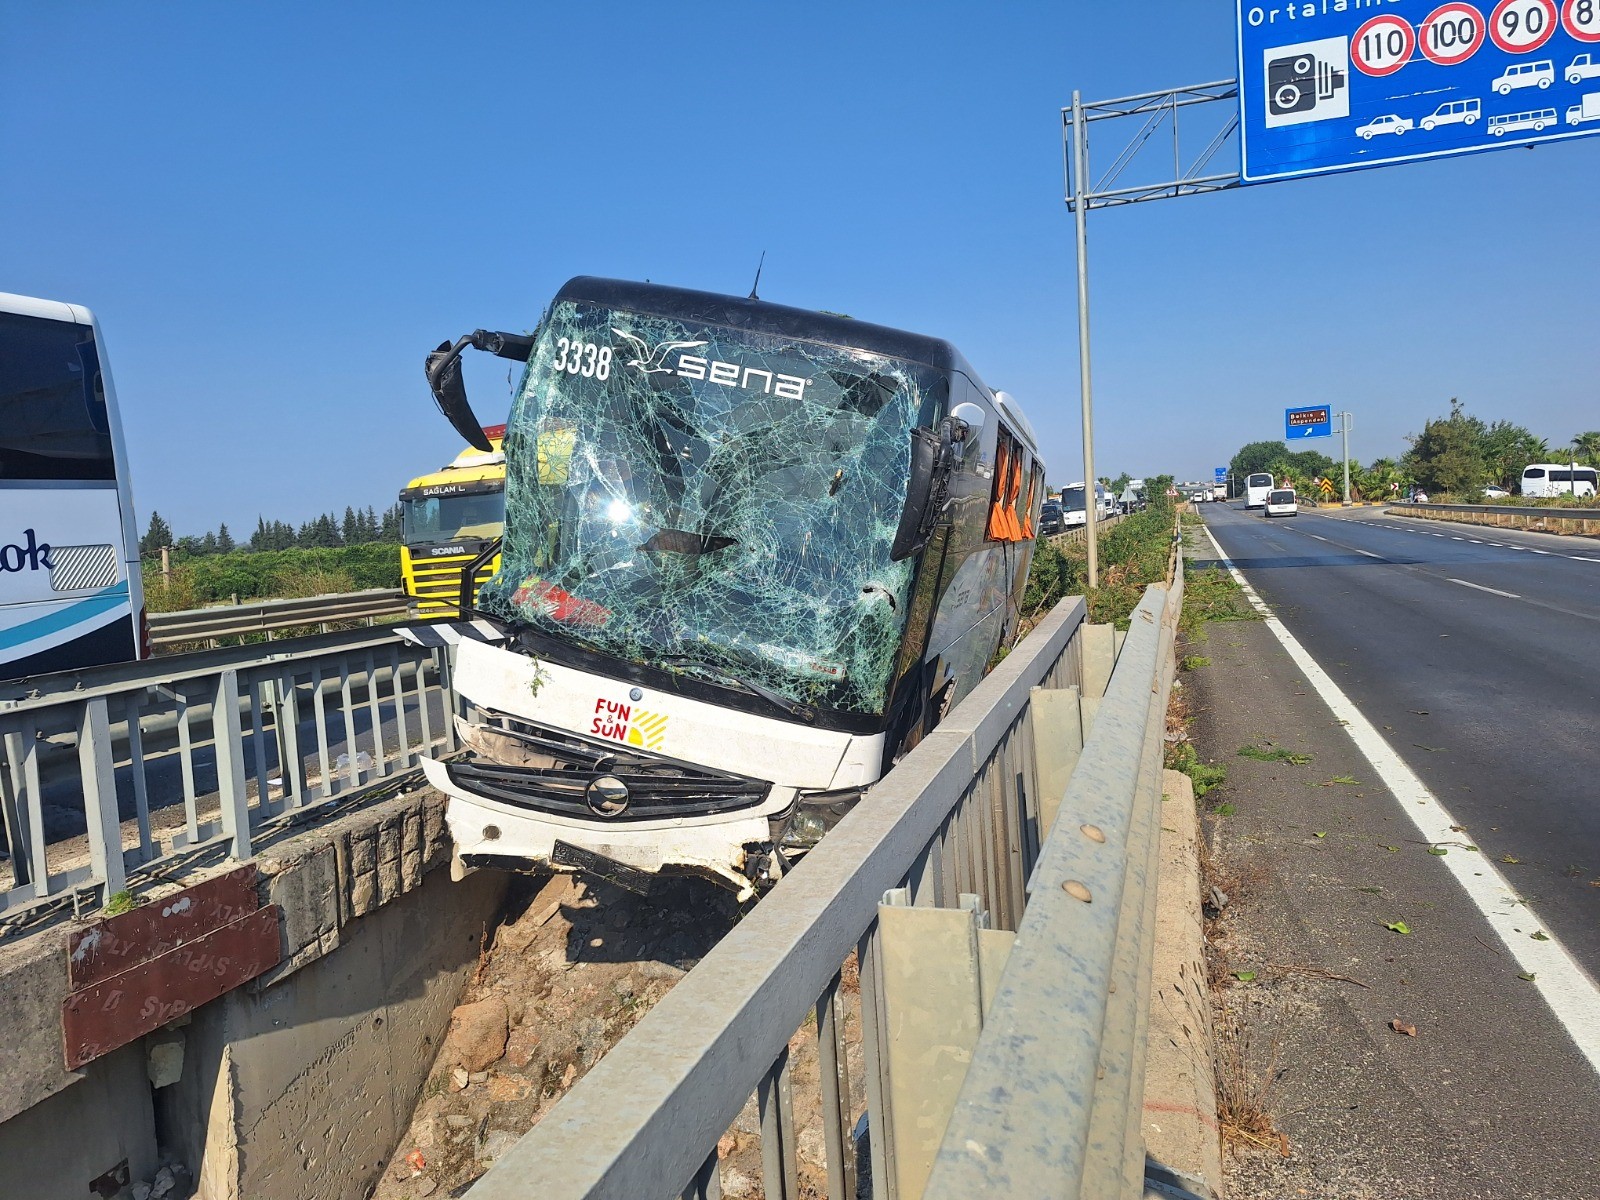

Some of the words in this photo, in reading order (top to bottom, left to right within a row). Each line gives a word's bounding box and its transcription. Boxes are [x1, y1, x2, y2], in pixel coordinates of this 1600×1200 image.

[1503, 6, 1544, 37] 90
[1576, 0, 1600, 25] 8
[1363, 29, 1404, 62] 110
[1431, 16, 1475, 50] 100
[553, 337, 612, 381] 3338
[0, 528, 56, 573] ok
[431, 546, 465, 556] SCANIA
[595, 698, 631, 721] FUN
[590, 717, 627, 741] SUN
